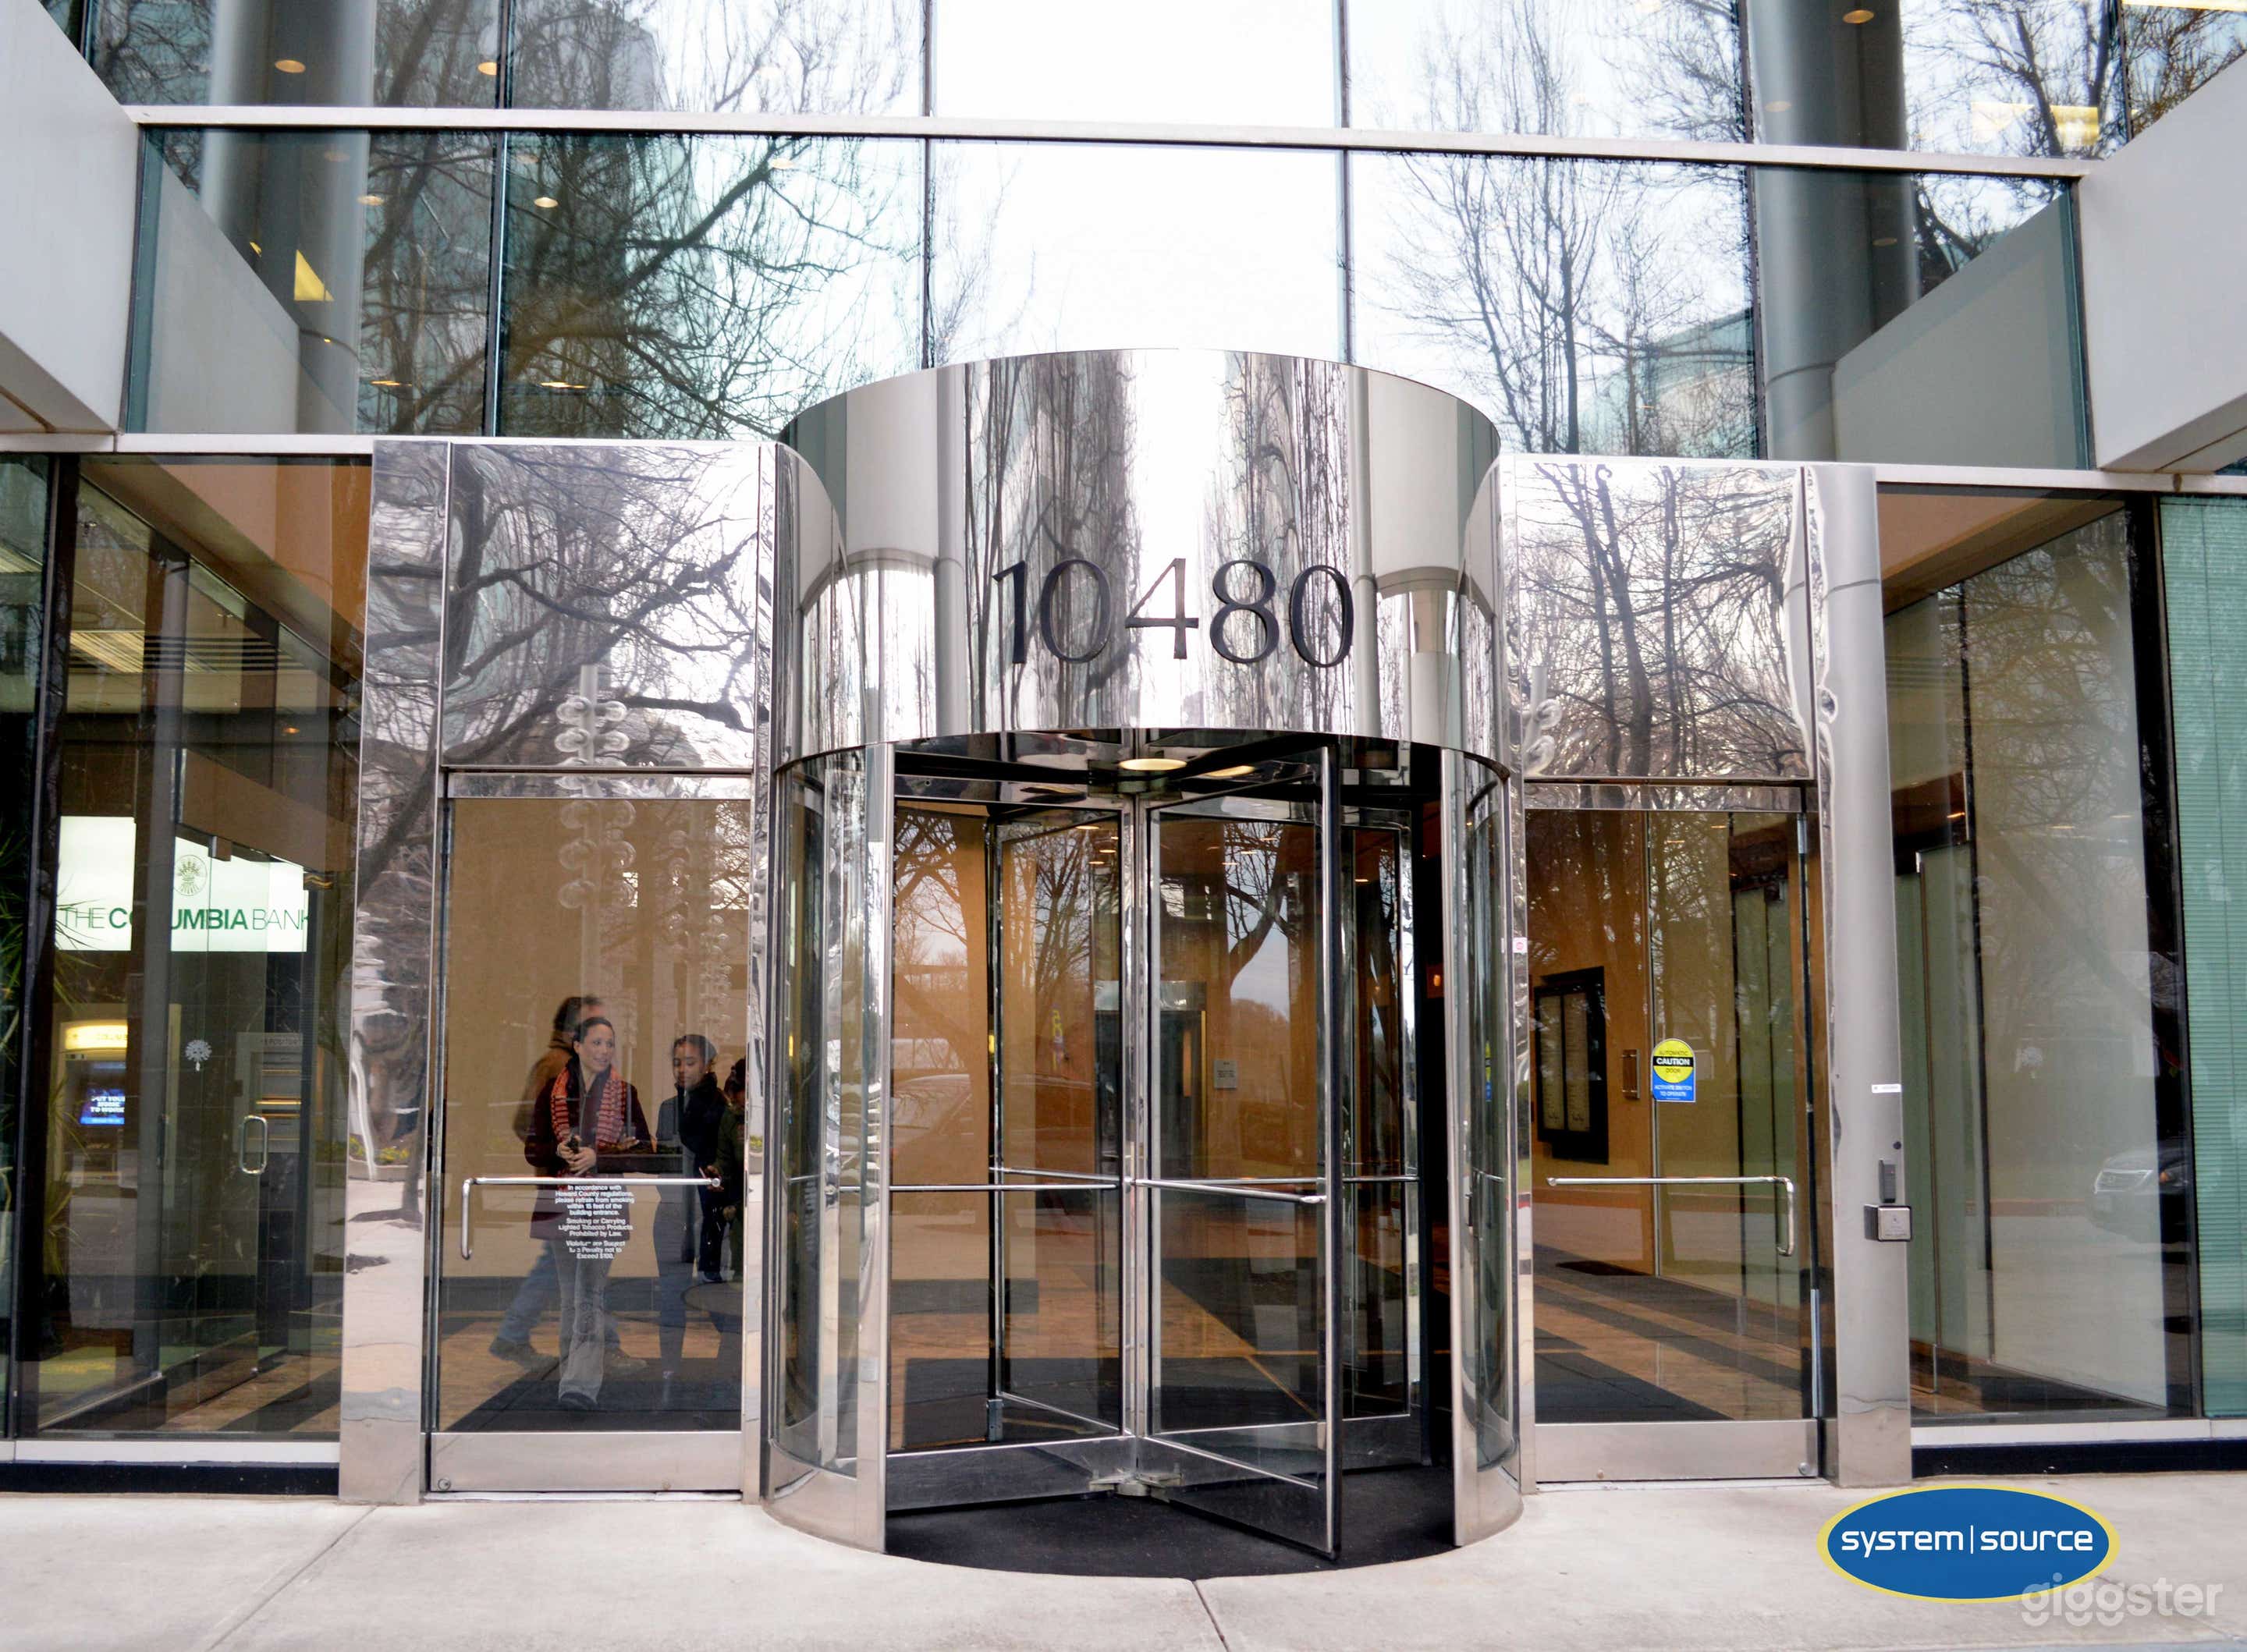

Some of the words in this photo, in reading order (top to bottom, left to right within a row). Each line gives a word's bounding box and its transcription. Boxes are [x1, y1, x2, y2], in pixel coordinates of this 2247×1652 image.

[992, 558, 1354, 667] 10480
[63, 908, 105, 928] THE
[109, 907, 248, 930] CUMBIA
